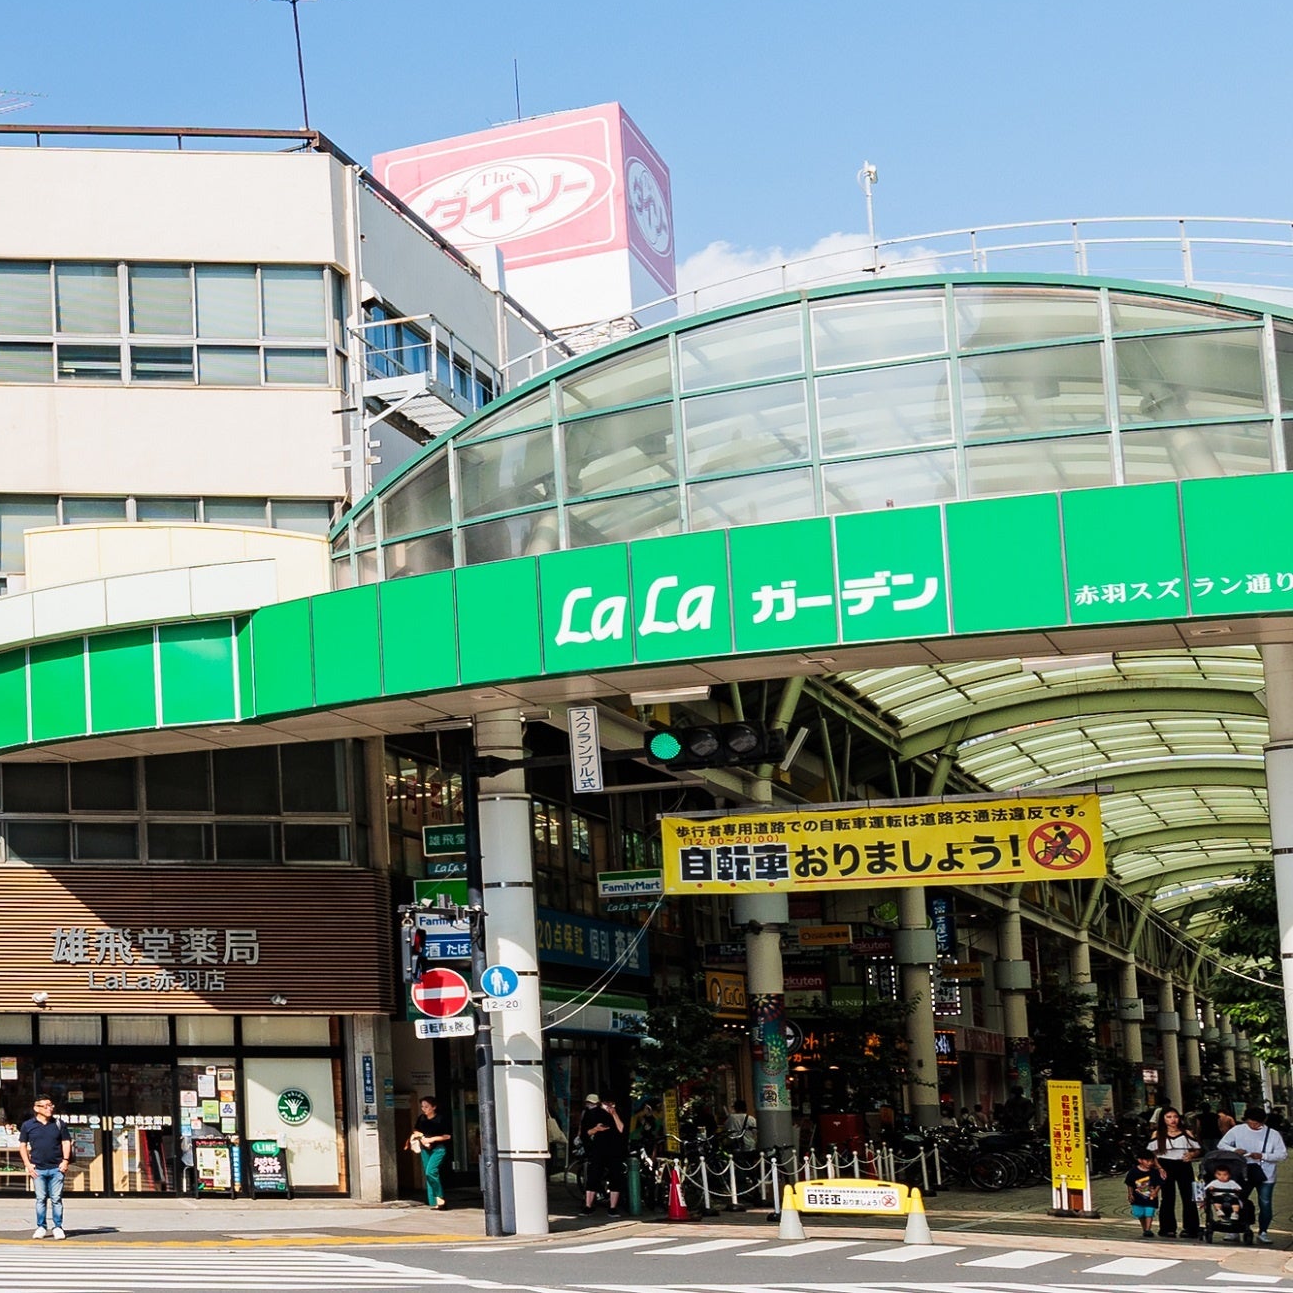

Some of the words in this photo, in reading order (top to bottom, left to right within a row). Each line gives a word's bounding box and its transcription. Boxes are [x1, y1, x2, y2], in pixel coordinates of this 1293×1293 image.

[481, 170, 516, 187] The
[422, 174, 588, 232] ダイソー
[751, 570, 939, 624] ガーデン
[1074, 572, 1293, 606] 赤羽スズラン通り
[576, 711, 596, 789] スクランブル式
[675, 805, 1086, 839] 歩行者専用道路での自転車運転は道路交通法違反です。
[602, 881, 661, 893] FamilyMart
[51, 927, 260, 966] 雄飛堂薬局
[446, 943, 472, 956] たば
[88, 969, 226, 992] LaLa赤羽店
[783, 976, 822, 987] akuten
[486, 1000, 519, 1009] 12-20
[420, 1021, 471, 1034] 自転車を除く
[256, 1143, 277, 1152] LINE
